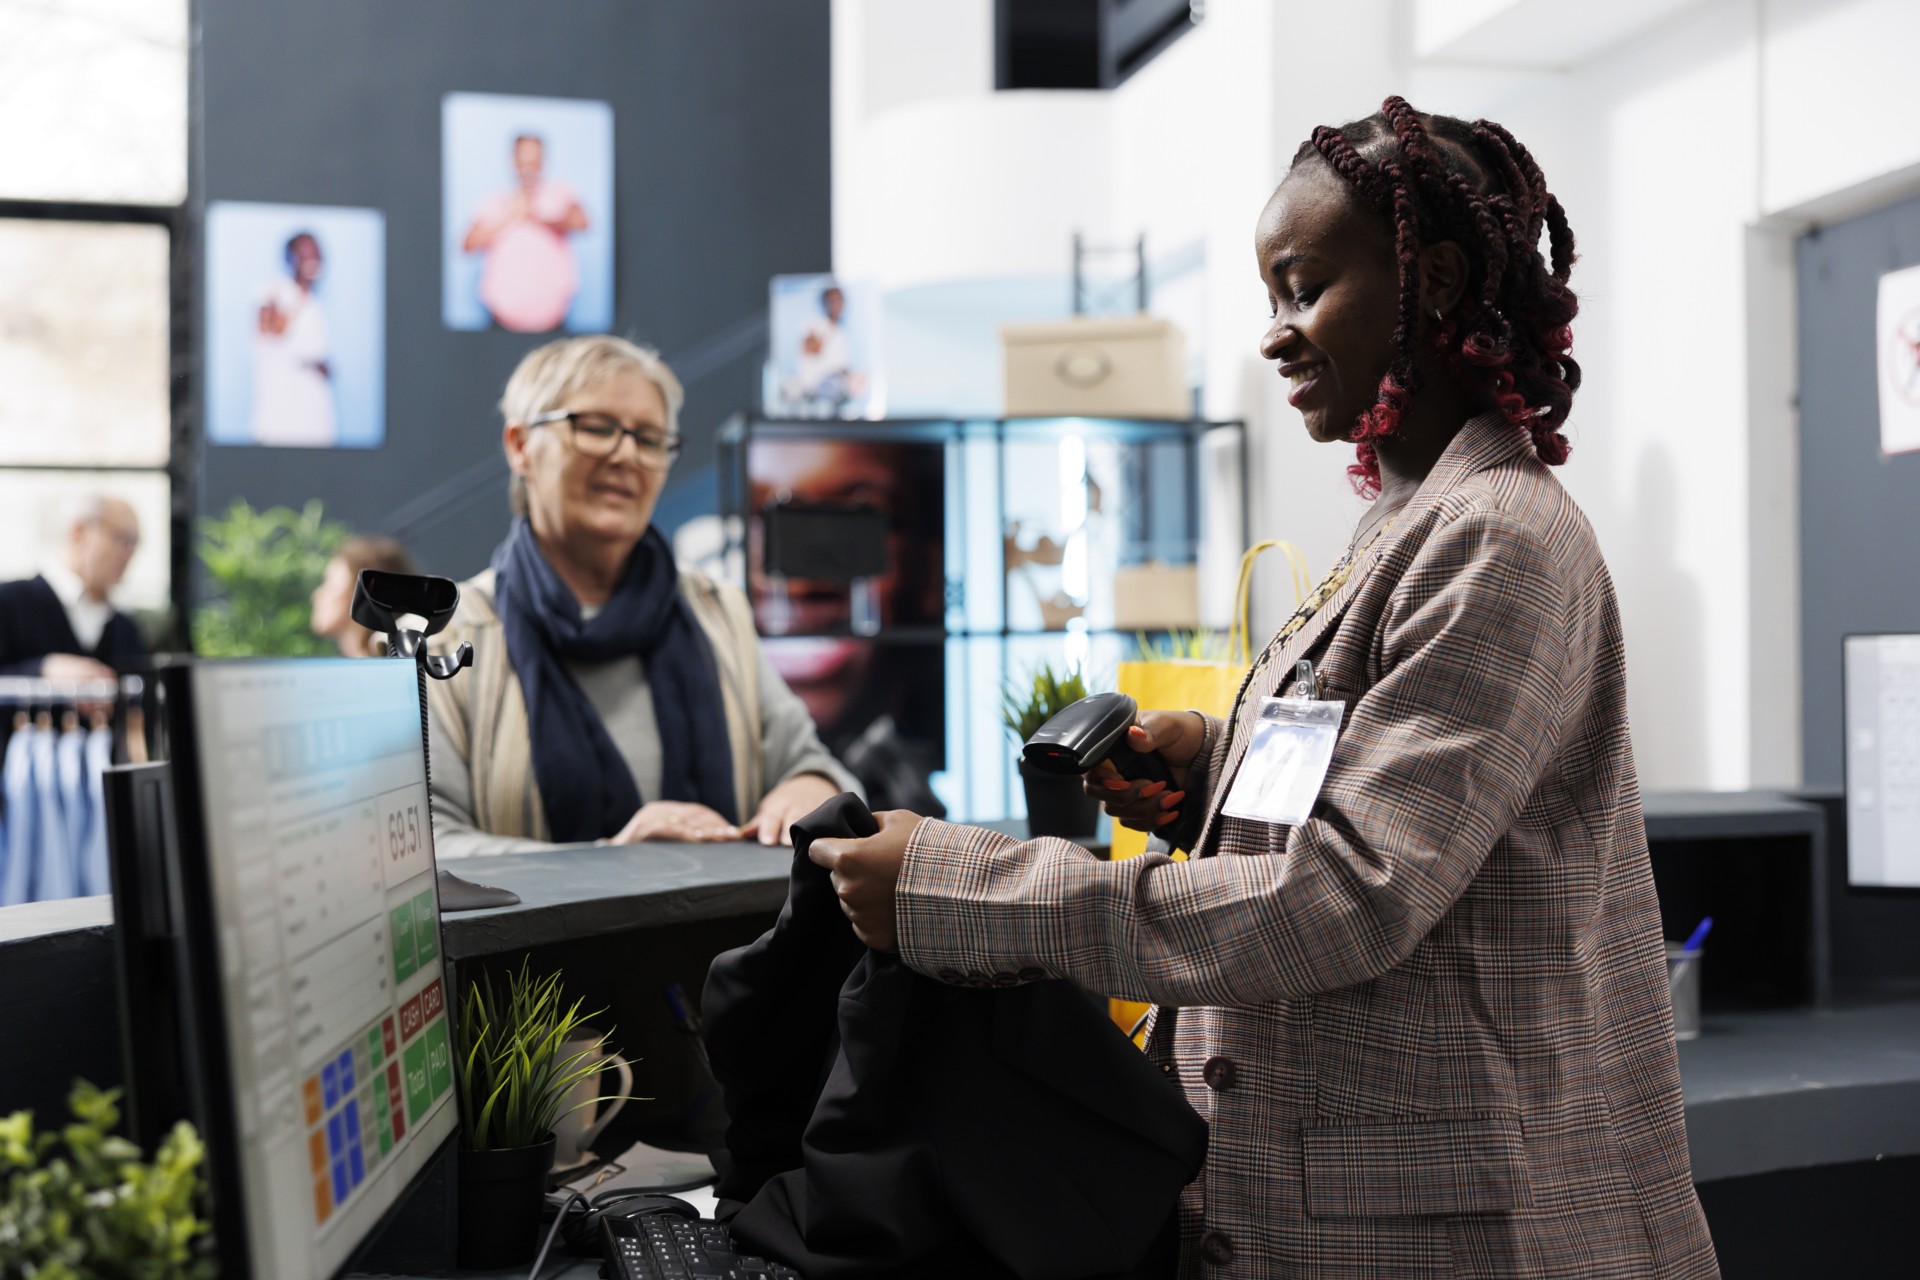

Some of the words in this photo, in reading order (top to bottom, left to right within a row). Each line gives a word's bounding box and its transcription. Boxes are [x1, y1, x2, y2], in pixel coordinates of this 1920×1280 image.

[389, 804, 421, 861] 69.51
[402, 1001, 421, 1034] CASH
[425, 986, 440, 1015] CARD
[430, 1042, 447, 1077] PAID
[408, 1060, 426, 1098] Total
